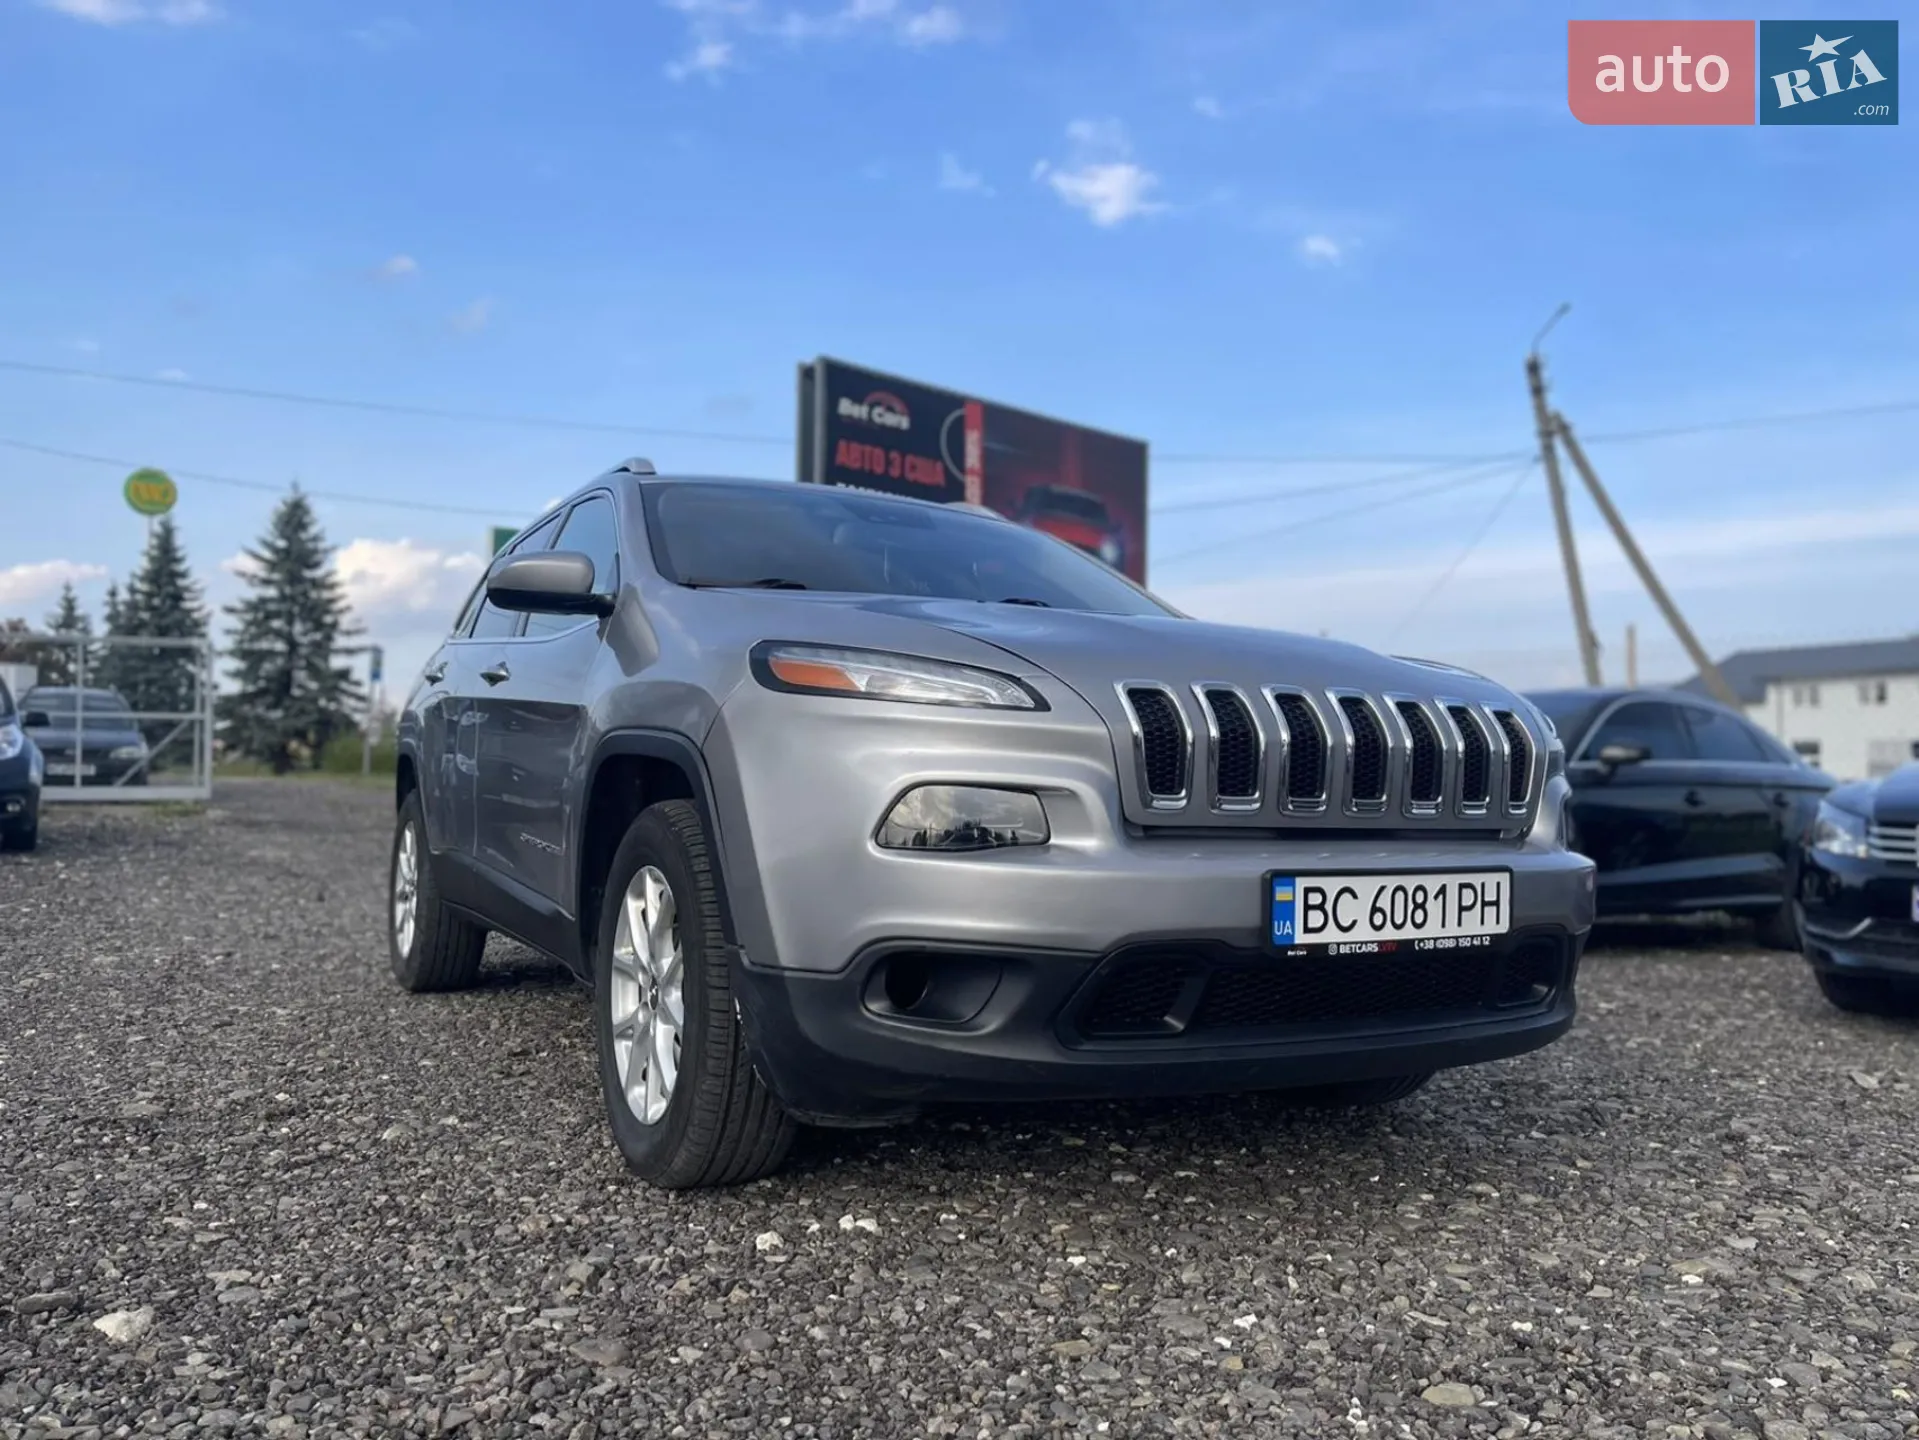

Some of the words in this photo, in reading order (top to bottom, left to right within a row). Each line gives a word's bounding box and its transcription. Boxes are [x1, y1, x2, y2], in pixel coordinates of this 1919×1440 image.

[835, 438, 886, 475] АВТО
[1302, 886, 1359, 934] BC
[1368, 883, 1448, 932] 6081
[1456, 880, 1501, 928] PH
[1274, 920, 1293, 936] UA
